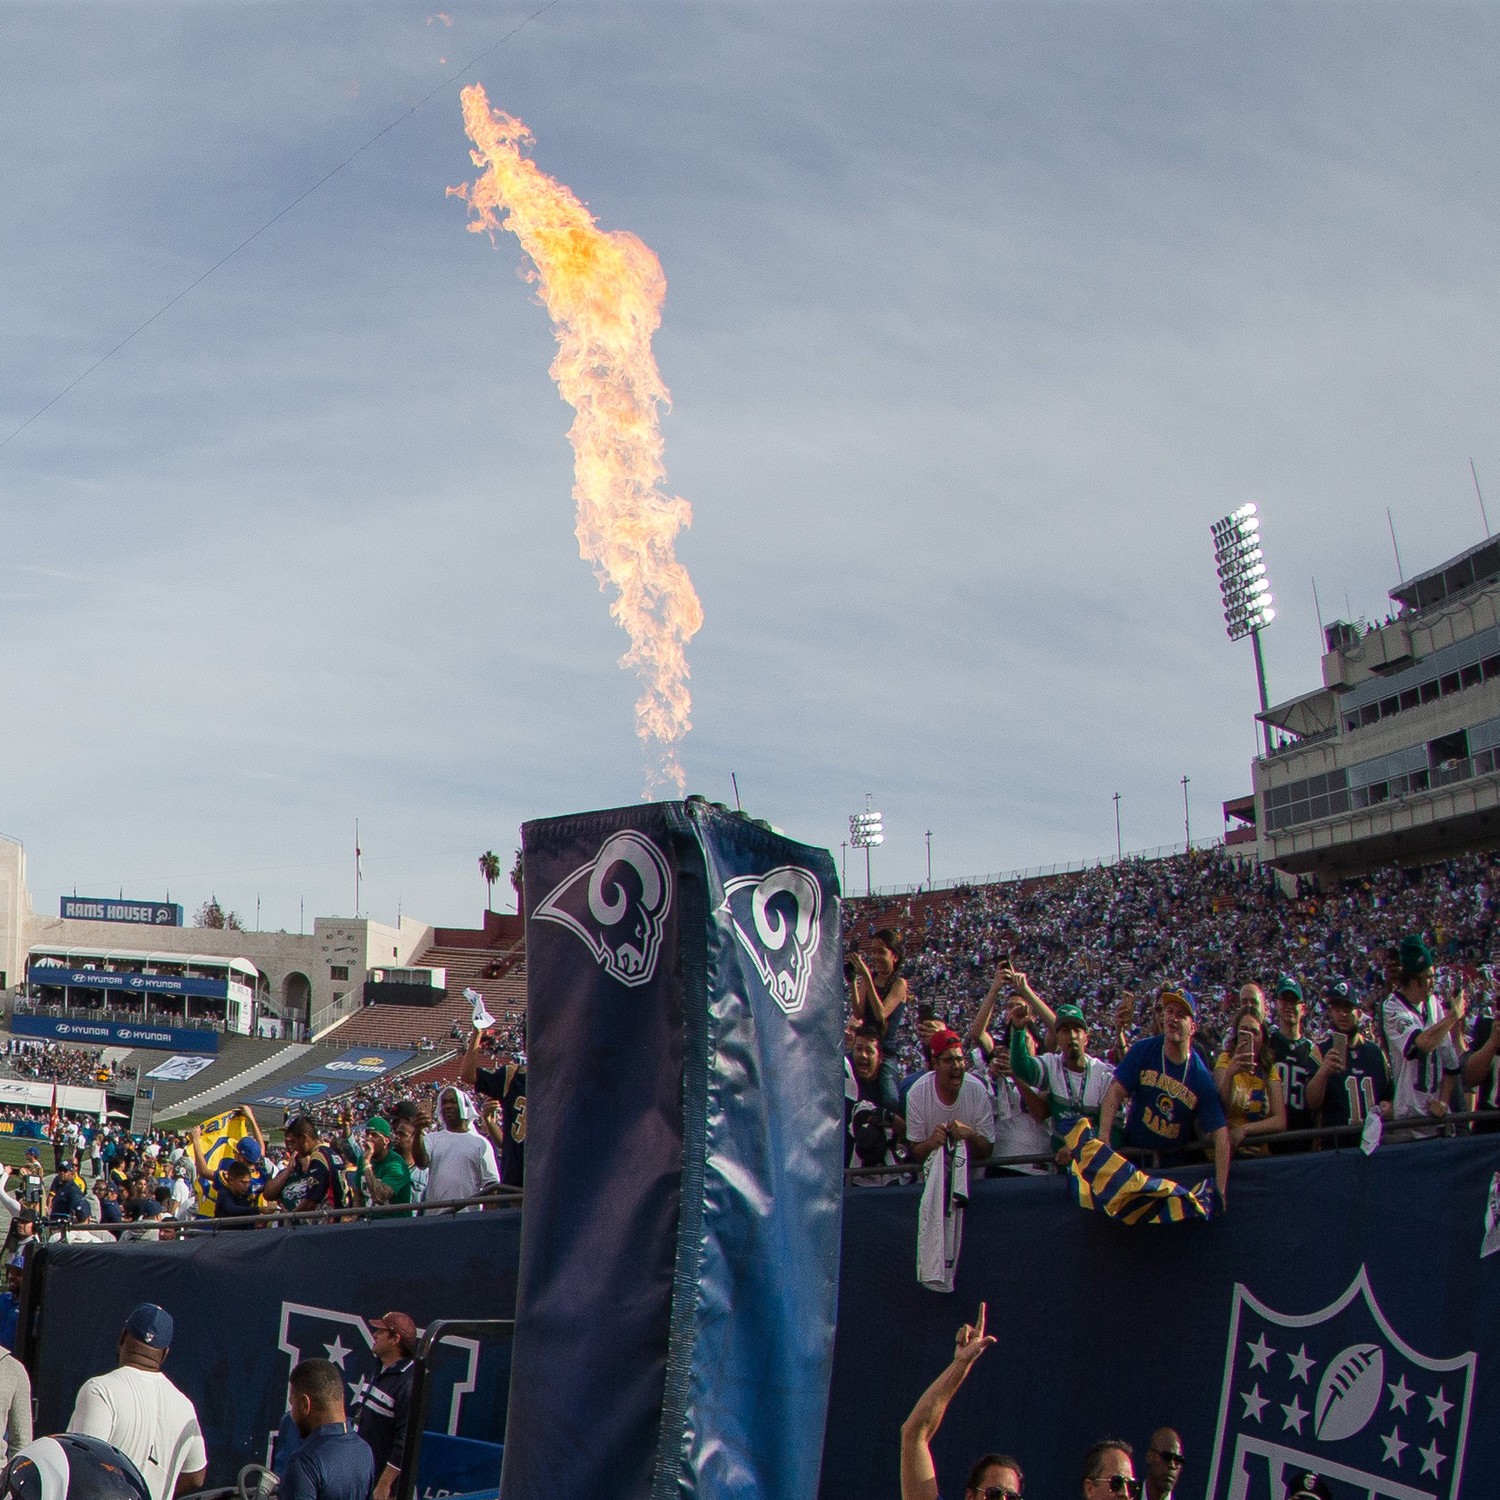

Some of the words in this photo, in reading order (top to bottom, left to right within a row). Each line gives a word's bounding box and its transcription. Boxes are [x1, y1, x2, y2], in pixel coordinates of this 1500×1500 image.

[66, 902, 104, 917] RAMS
[107, 904, 152, 922] HOUSE!
[87, 975, 122, 985] HYUNDAI
[145, 980, 181, 989] HYUNDAI
[72, 1025, 109, 1036] HYUNDAI
[133, 1031, 171, 1042] HYUNDAI
[324, 1061, 387, 1073] Corona
[1143, 1106, 1181, 1140] RAMS
